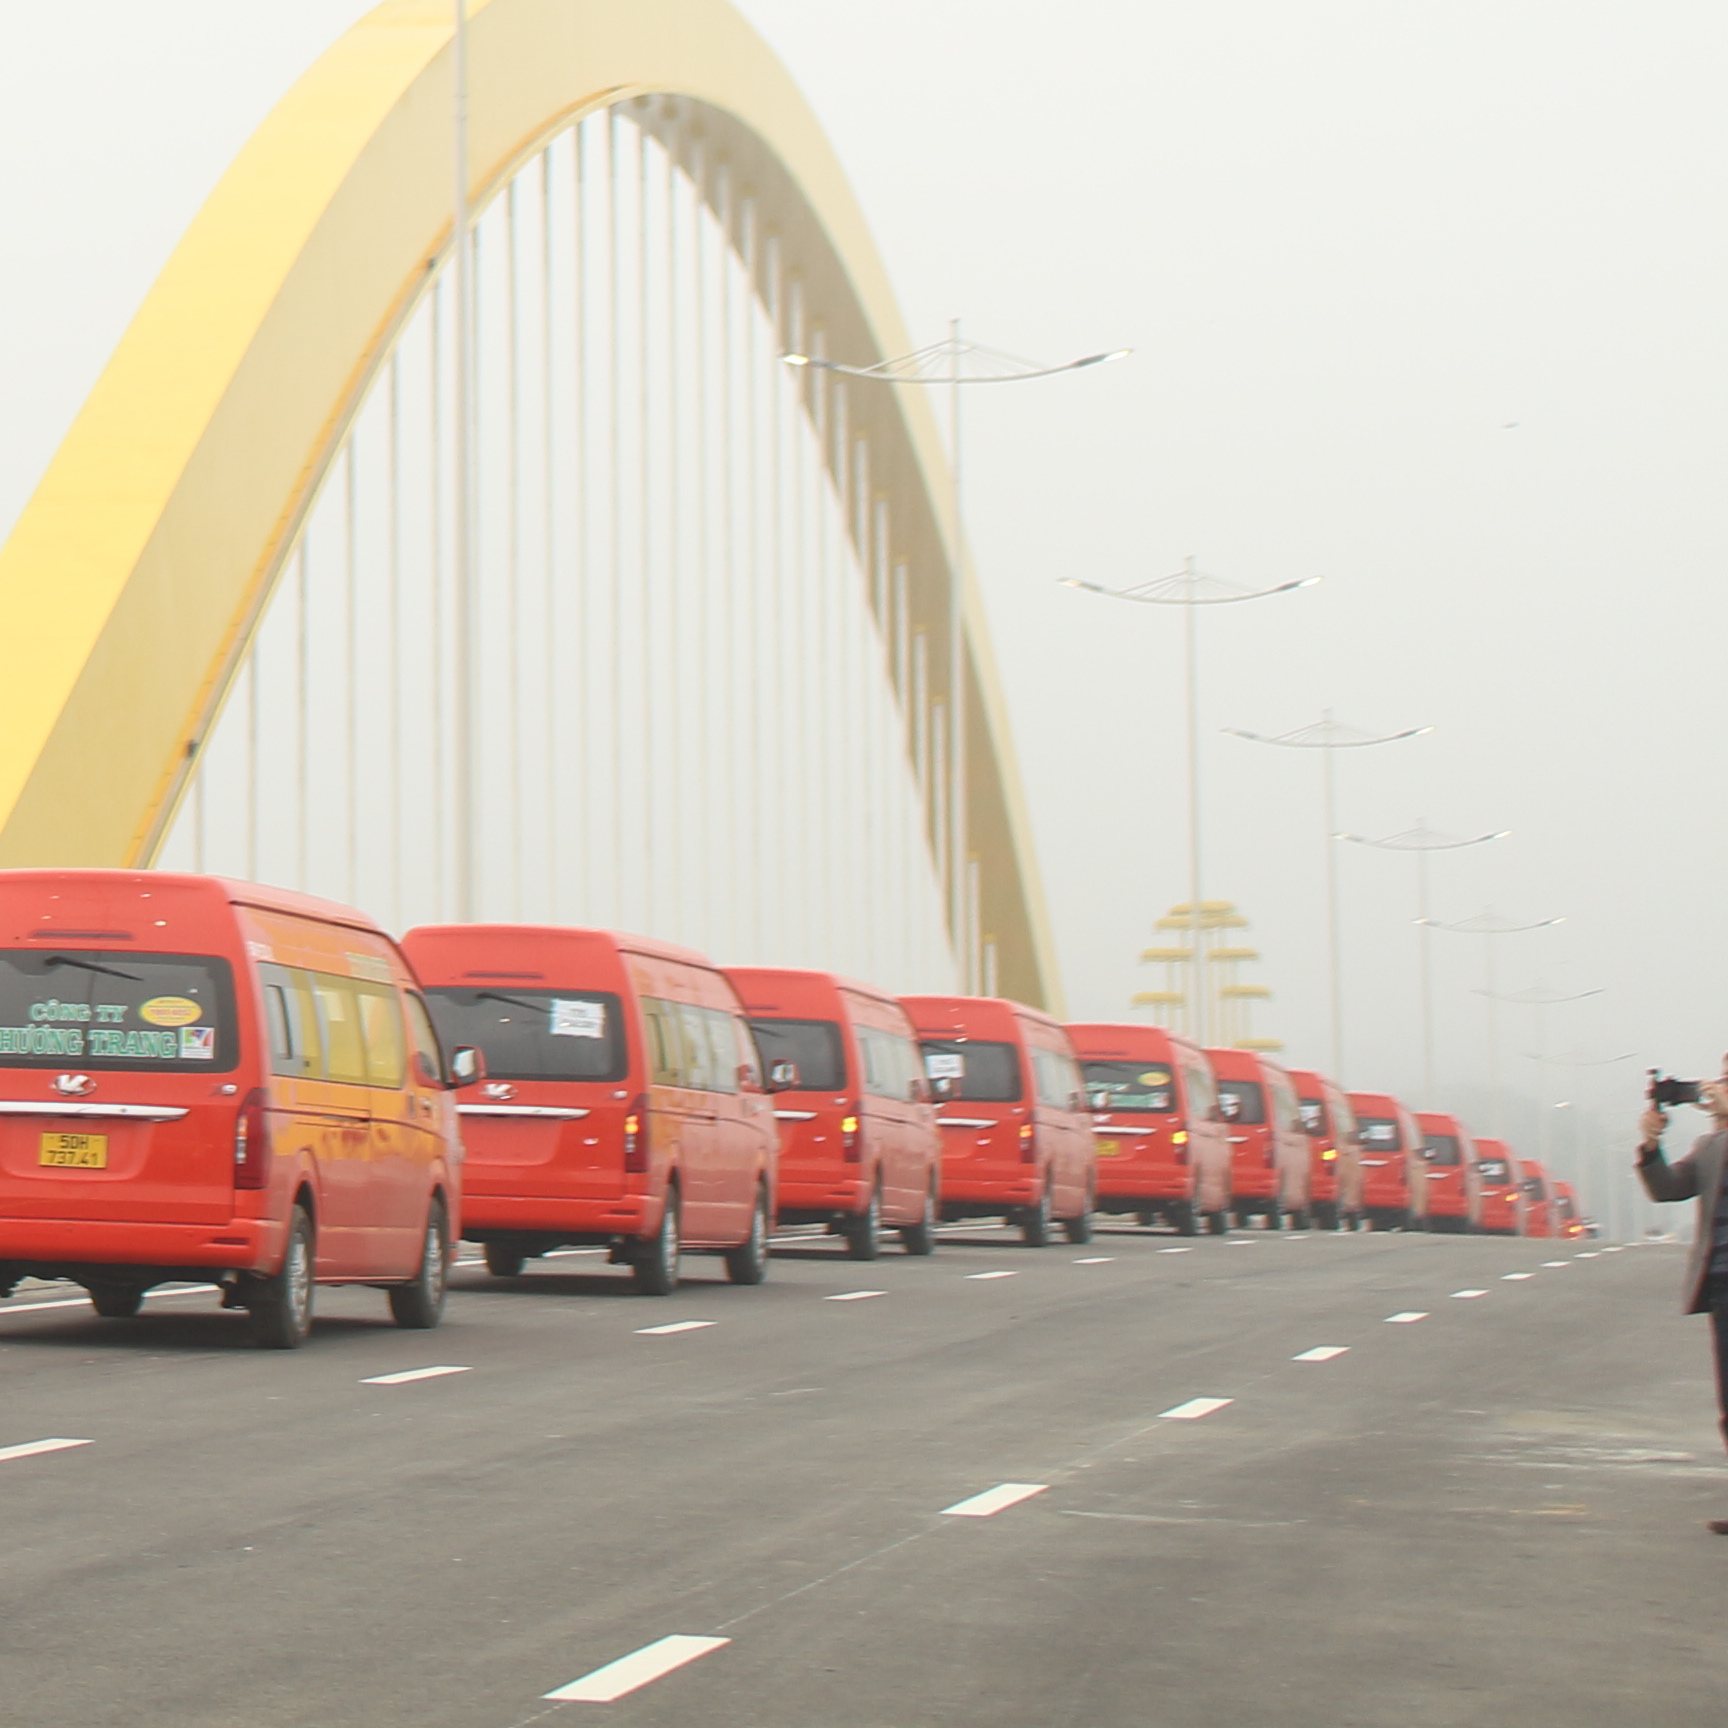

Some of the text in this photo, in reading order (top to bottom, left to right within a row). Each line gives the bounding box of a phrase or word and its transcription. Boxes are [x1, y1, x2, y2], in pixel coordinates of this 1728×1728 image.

[30, 998, 92, 1023] CÔNG
[95, 1004, 129, 1023] TY
[88, 1029, 179, 1060] TRANG
[47, 1150, 99, 1166] 737.41
